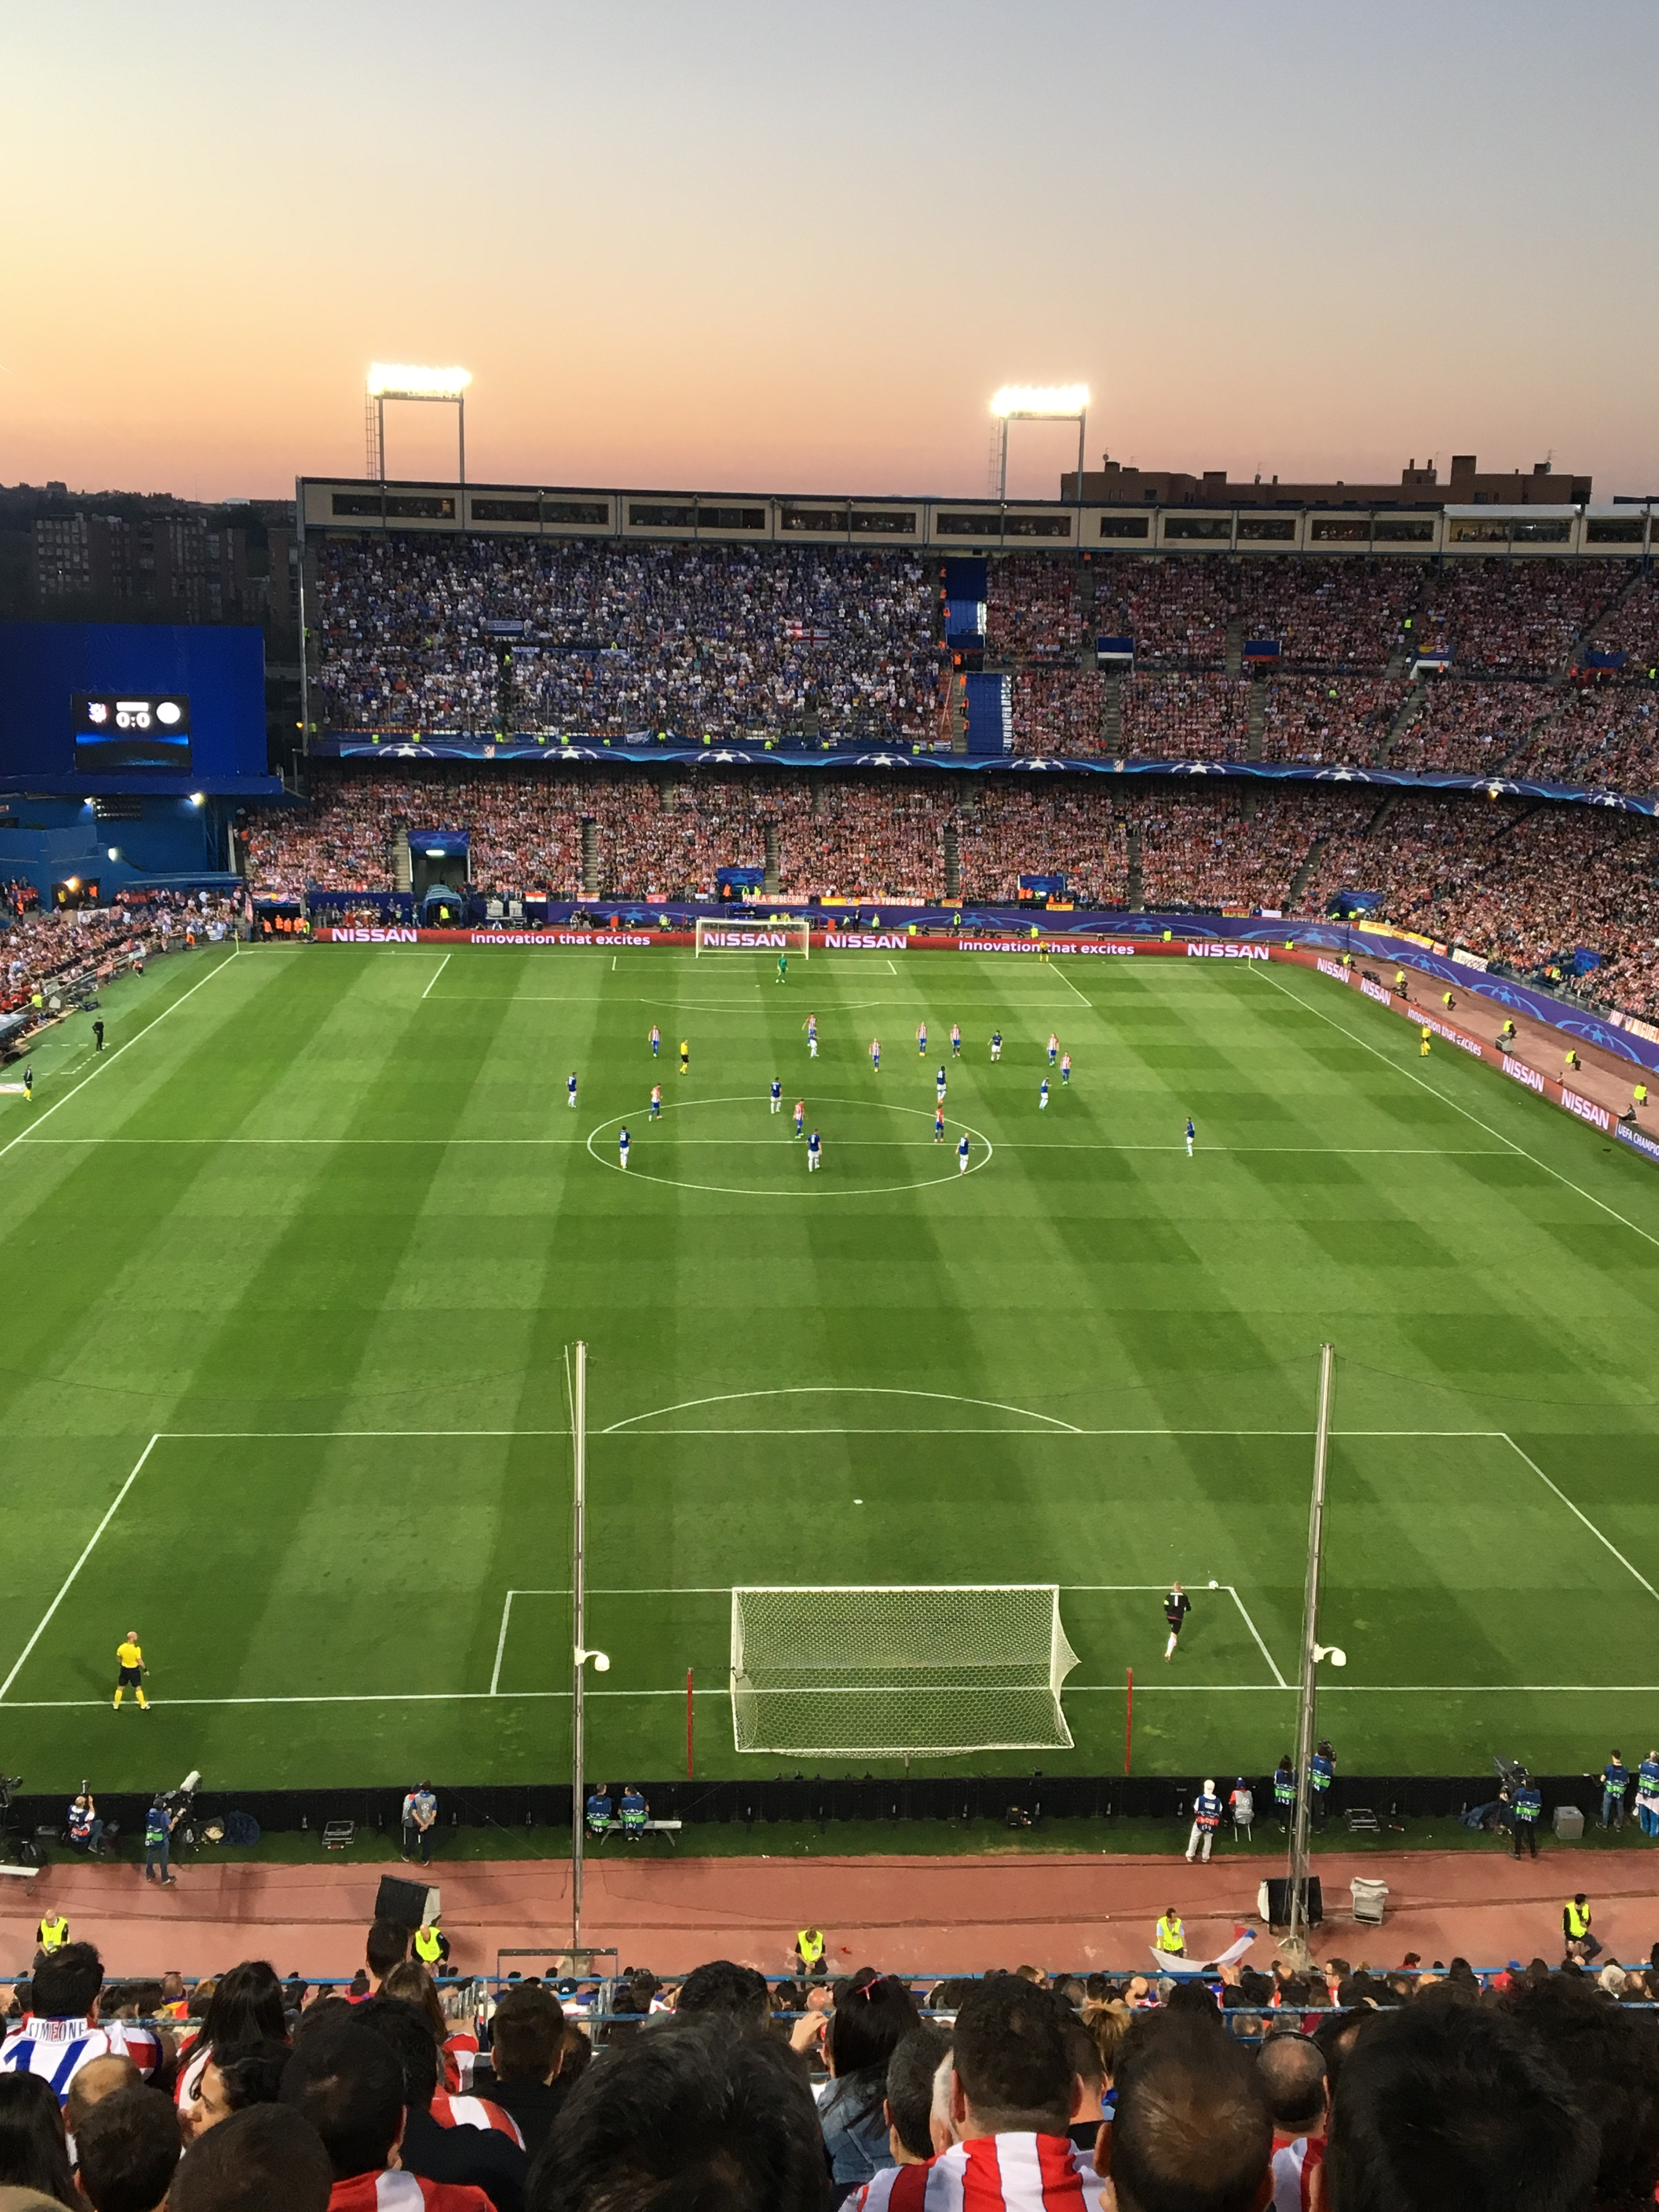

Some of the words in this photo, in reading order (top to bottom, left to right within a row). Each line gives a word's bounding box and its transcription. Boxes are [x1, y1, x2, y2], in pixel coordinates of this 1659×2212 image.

[779, 896, 809, 904] BECERRA
[881, 897, 910, 905] YUNCOS
[332, 929, 417, 943] NISSAN
[471, 933, 555, 944] Innovation
[560, 933, 592, 945] that
[596, 934, 651, 945] excites
[703, 933, 787, 947] NISSAN
[825, 935, 907, 949] NISSAN
[959, 940, 1041, 952] Innovation
[1081, 943, 1135, 955] excites
[1187, 943, 1269, 960] NISSAN
[1317, 957, 1351, 983] NISSAN
[1360, 977, 1391, 1006] NISSAN
[1441, 1024, 1457, 1042] that
[1502, 1054, 1544, 1092] NISSAN
[1561, 1088, 1610, 1130] NISSAN
[1618, 1124, 1632, 1141] UEFA
[29, 2022, 85, 2042] SIMEONE
